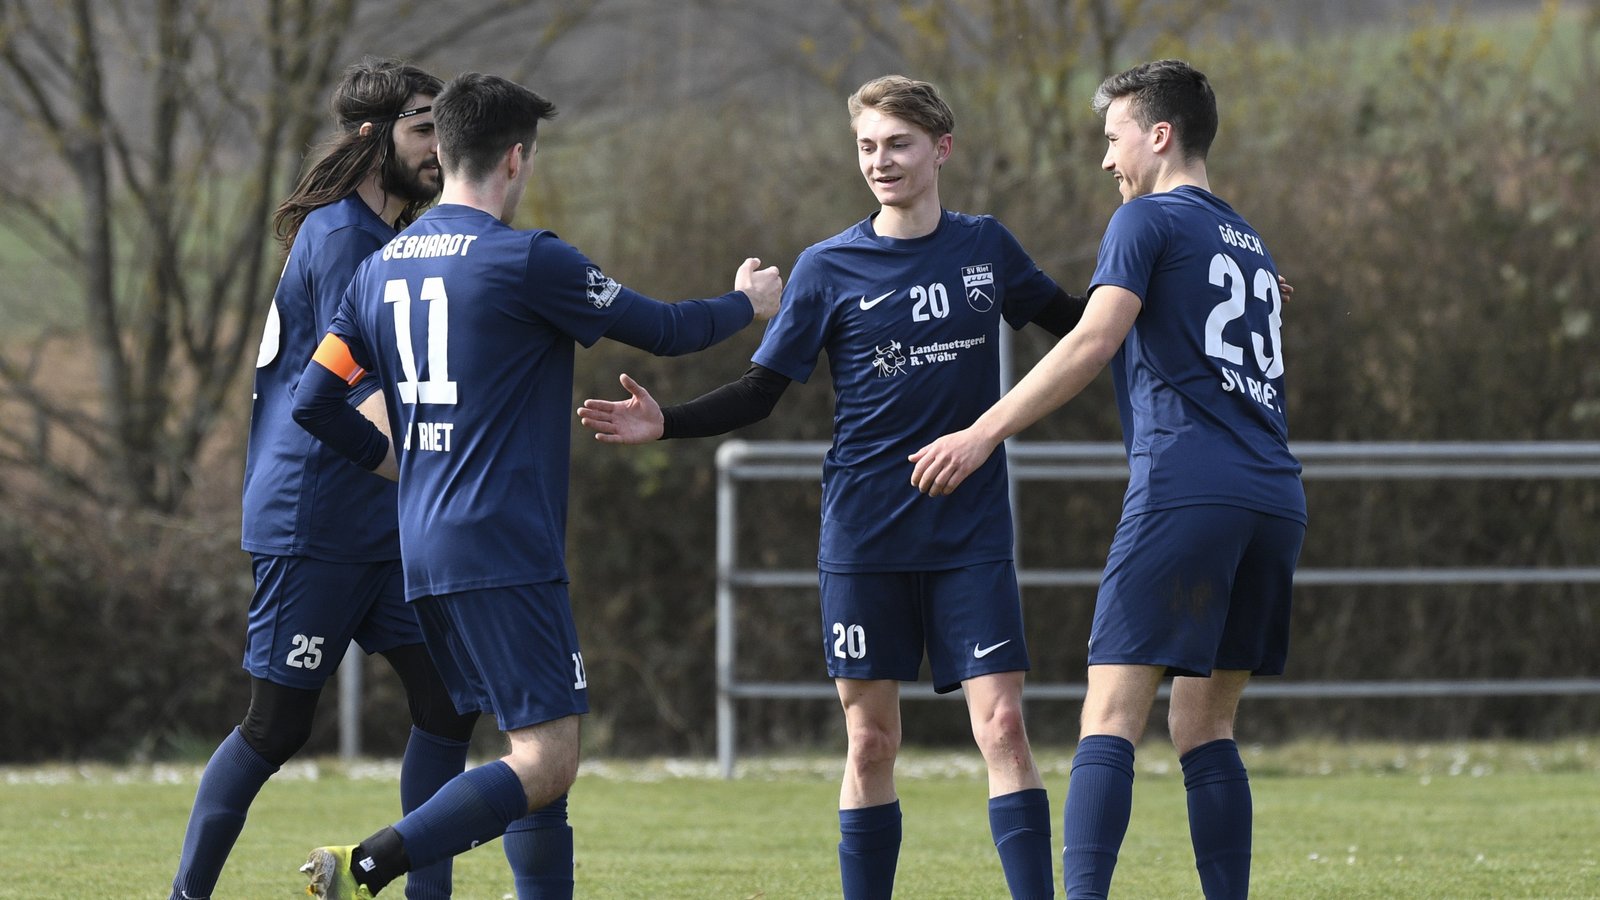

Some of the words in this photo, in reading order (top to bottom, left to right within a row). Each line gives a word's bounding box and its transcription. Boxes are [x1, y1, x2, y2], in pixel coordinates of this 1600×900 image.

[382, 234, 477, 261] GEBHARDT
[1218, 224, 1264, 256] GÖSCH
[910, 283, 950, 322] 20
[1205, 253, 1284, 380] 23
[384, 276, 458, 405] 11
[909, 334, 986, 355] Landmetzgerei
[909, 356, 924, 366] R.
[925, 351, 958, 364] Wöhr
[1221, 366, 1246, 394] SV
[417, 422, 454, 452] RIET
[285, 634, 325, 670] 25
[832, 622, 867, 660] 20
